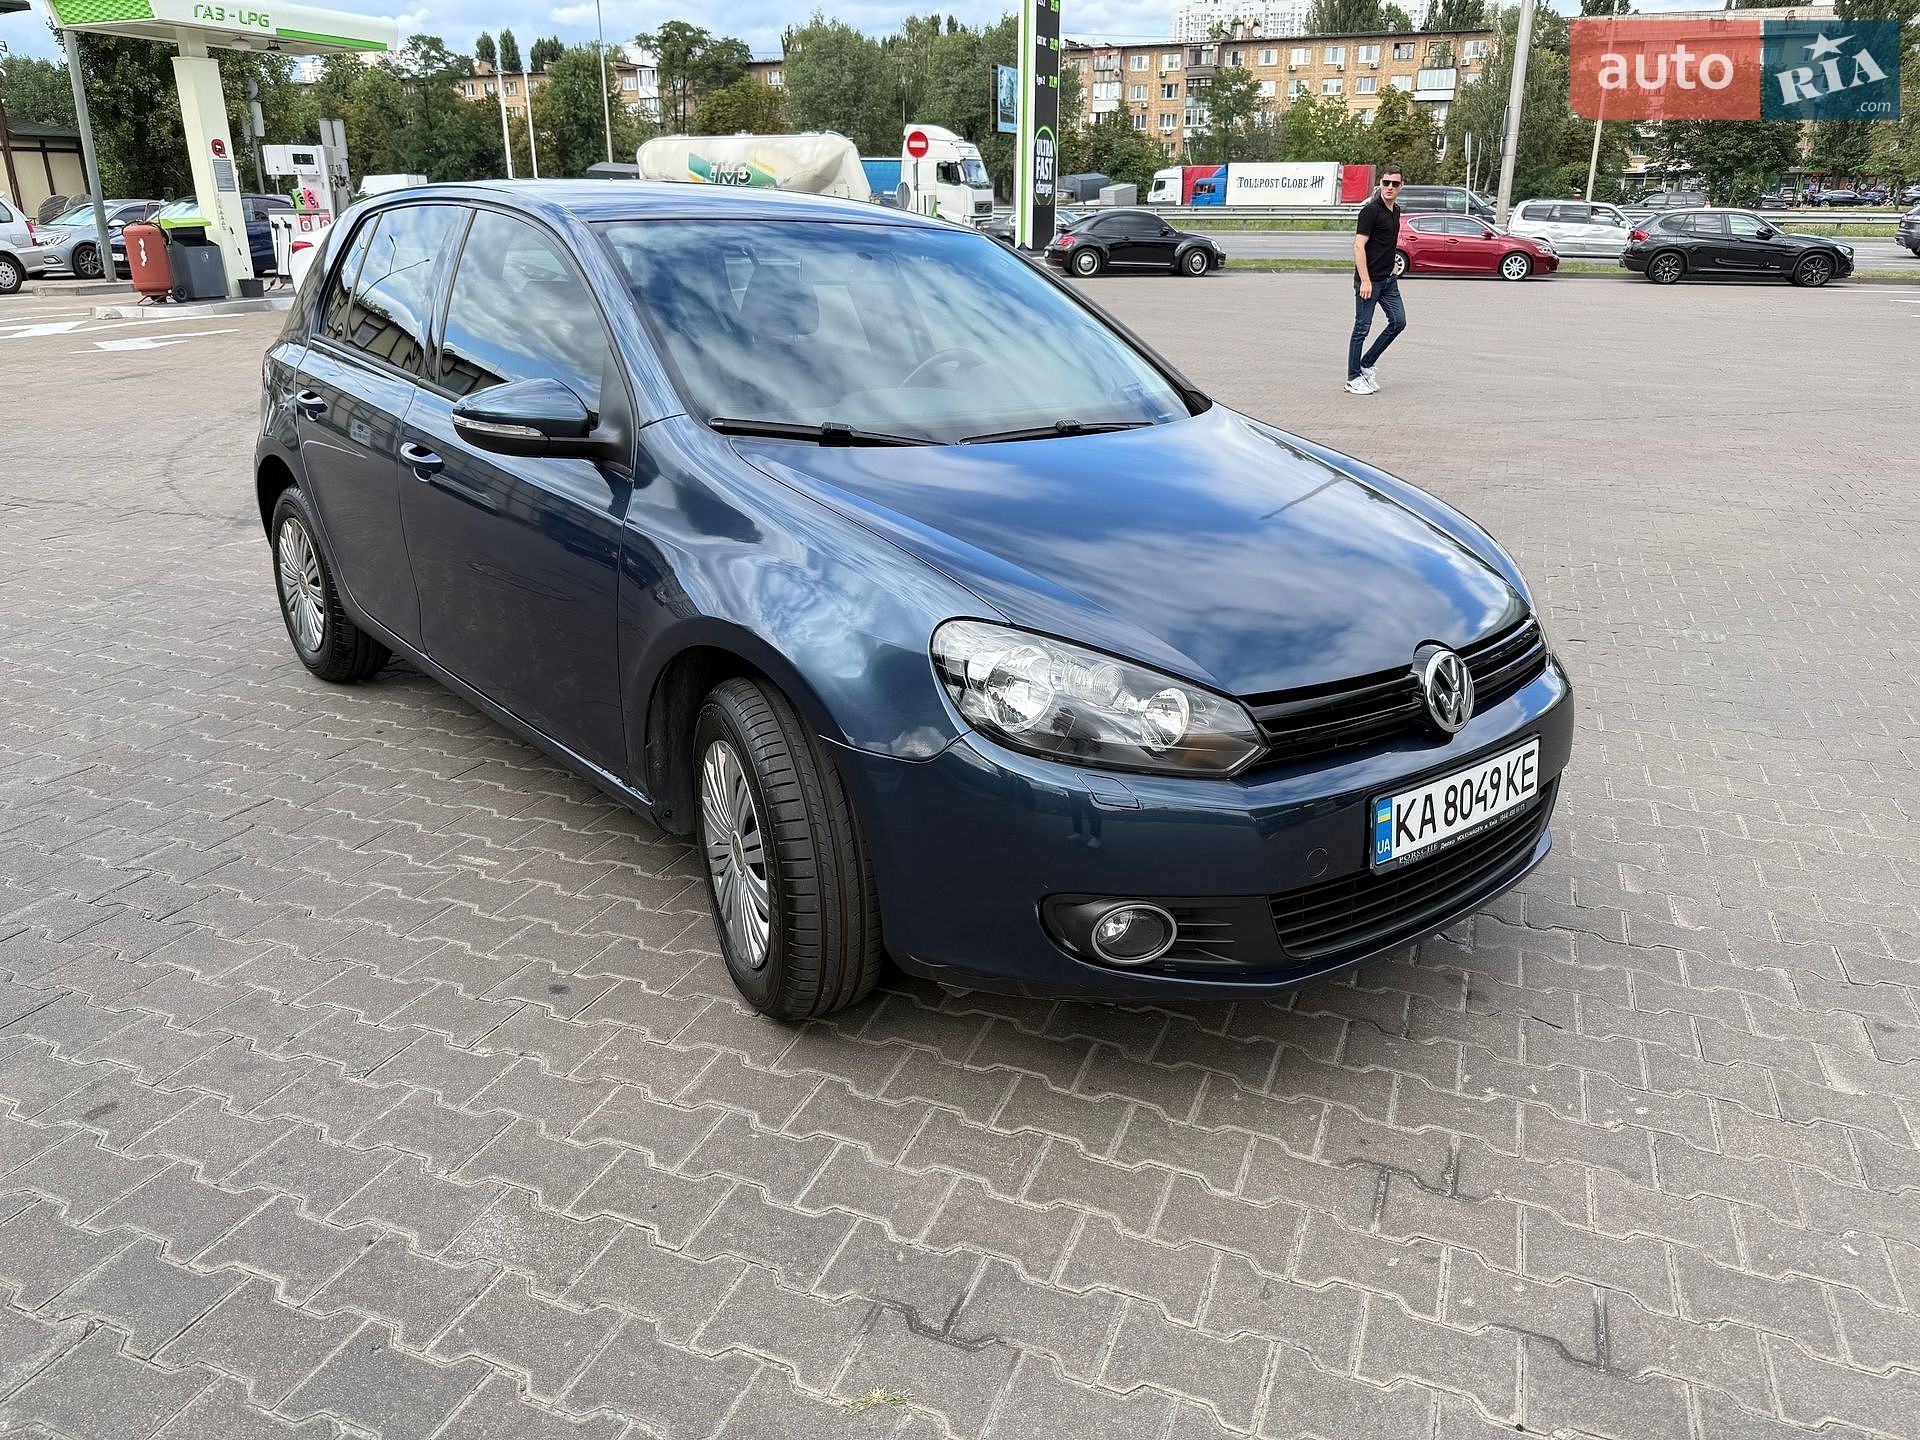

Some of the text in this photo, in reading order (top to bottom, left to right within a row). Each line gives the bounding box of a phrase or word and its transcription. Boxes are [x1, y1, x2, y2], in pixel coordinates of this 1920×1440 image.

[194, 4, 225, 21] ГАЗ
[239, 10, 270, 27] LPG
[1036, 139, 1053, 157] ULTRA
[1036, 156, 1053, 180] FAST
[1036, 180, 1053, 197] charger
[1281, 177, 1308, 188] GLOBE
[1396, 749, 1536, 848] KA 8049 KE
[1376, 838, 1391, 854] UA
[1399, 843, 1438, 863] PORSCHE
